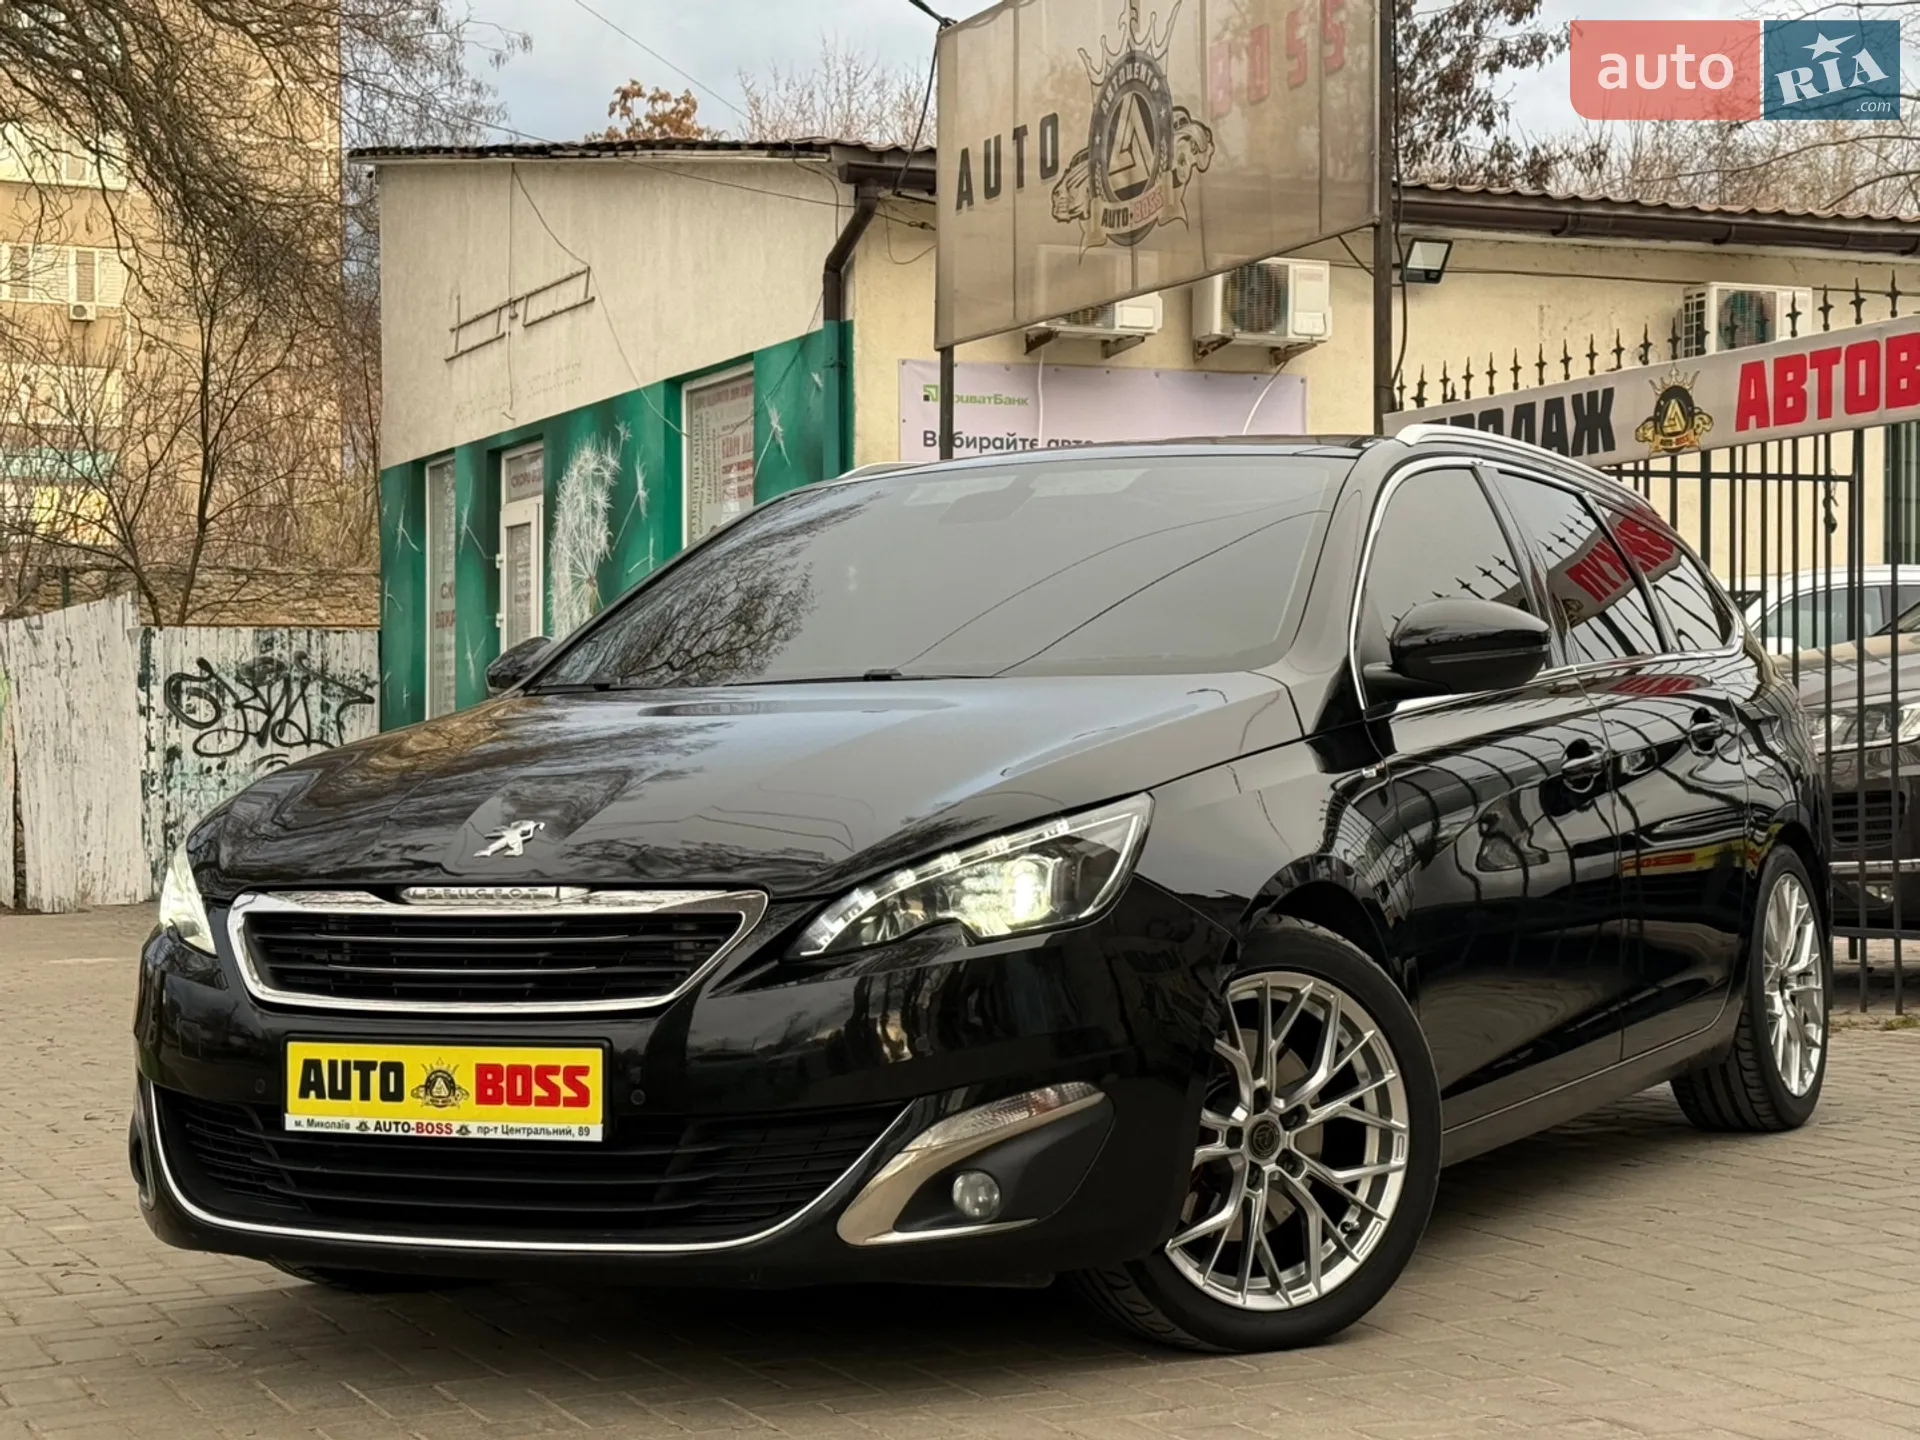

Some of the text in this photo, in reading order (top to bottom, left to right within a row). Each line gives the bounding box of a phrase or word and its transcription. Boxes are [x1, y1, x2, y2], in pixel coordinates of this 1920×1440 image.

[956, 0, 1346, 212] AUTO BOSS
[923, 430, 1040, 453] Вбирайте
[298, 1058, 590, 1108] AUTO BOSS
[373, 1120, 453, 1135] AUTO-BOSS
[476, 1126, 498, 1137] пр-т
[577, 1125, 591, 1137] 89
